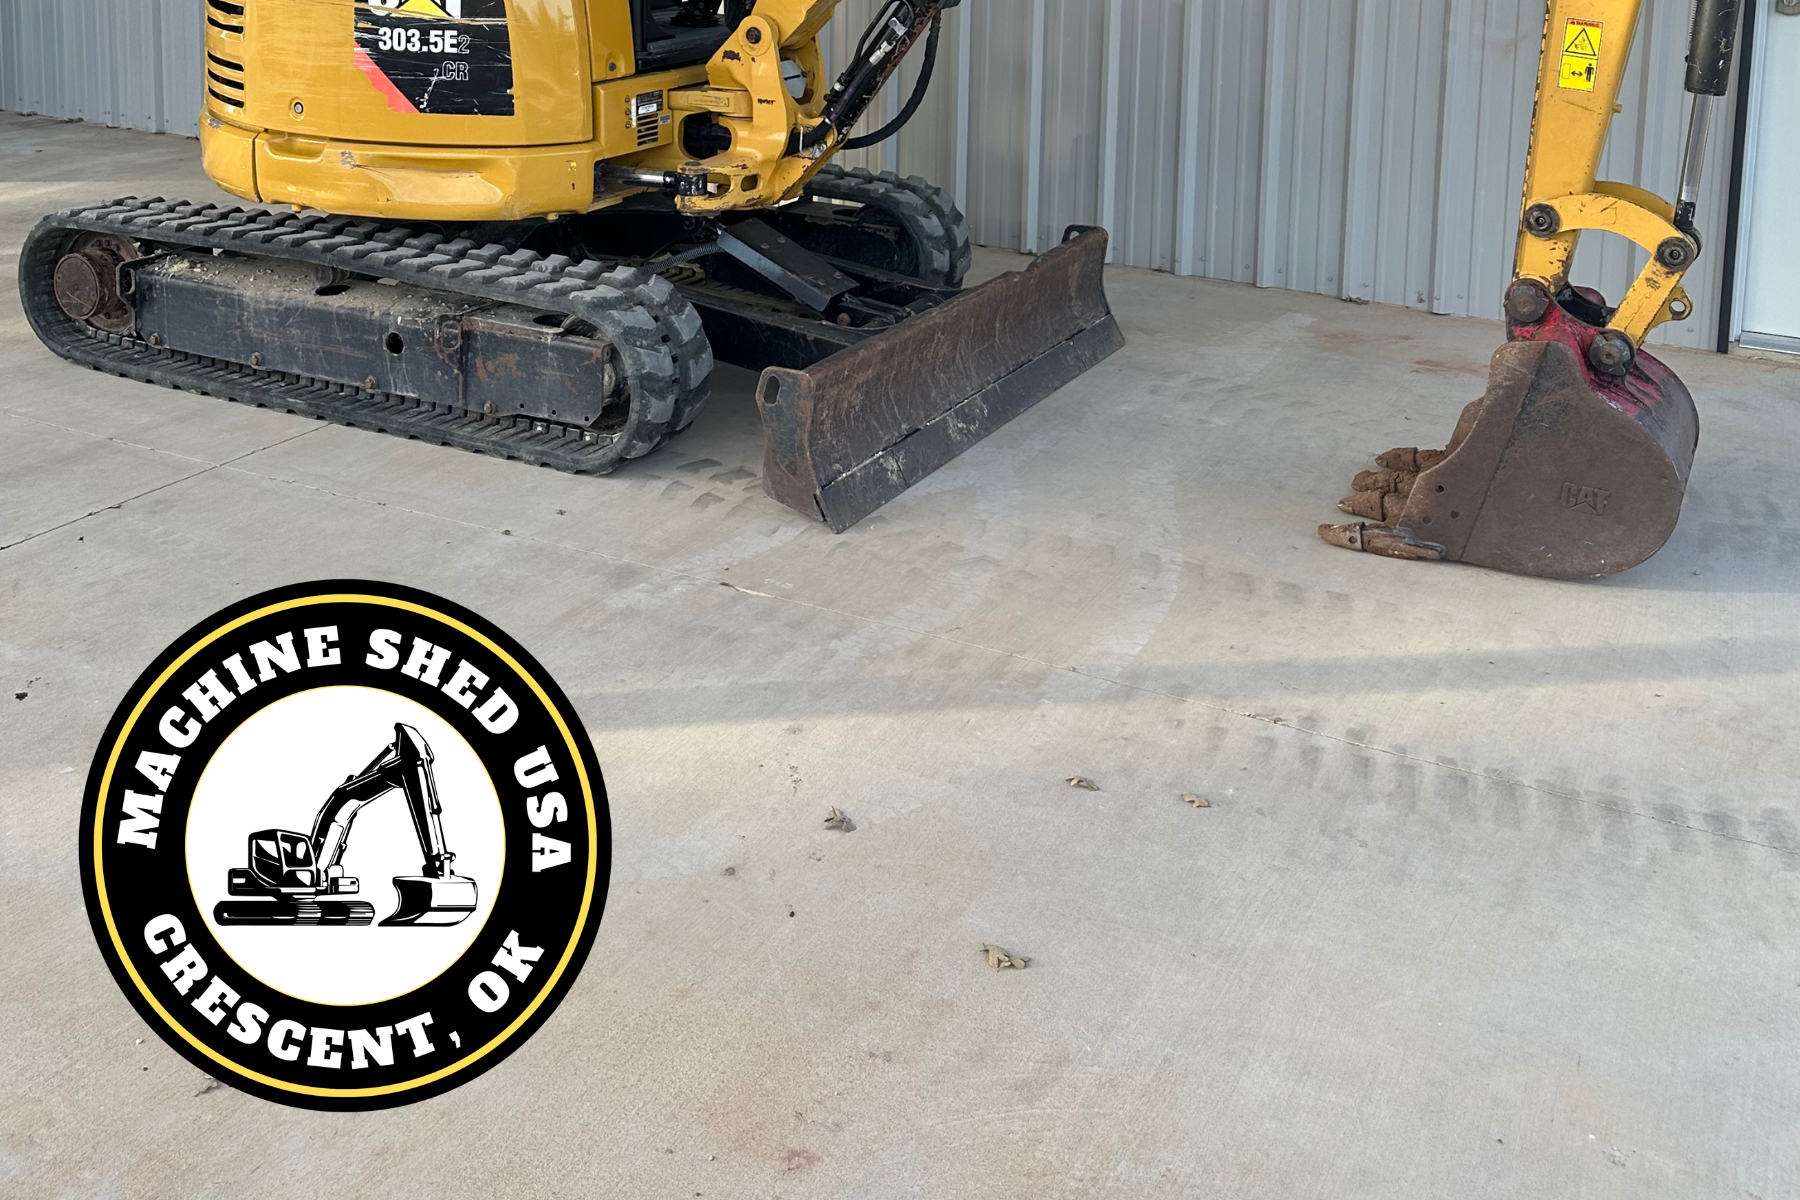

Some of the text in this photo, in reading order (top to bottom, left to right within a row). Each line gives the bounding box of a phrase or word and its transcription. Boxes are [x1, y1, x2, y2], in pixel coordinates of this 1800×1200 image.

[378, 27, 470, 54] 303.5E2
[442, 61, 469, 81] CR
[1560, 482, 1611, 516] CAT
